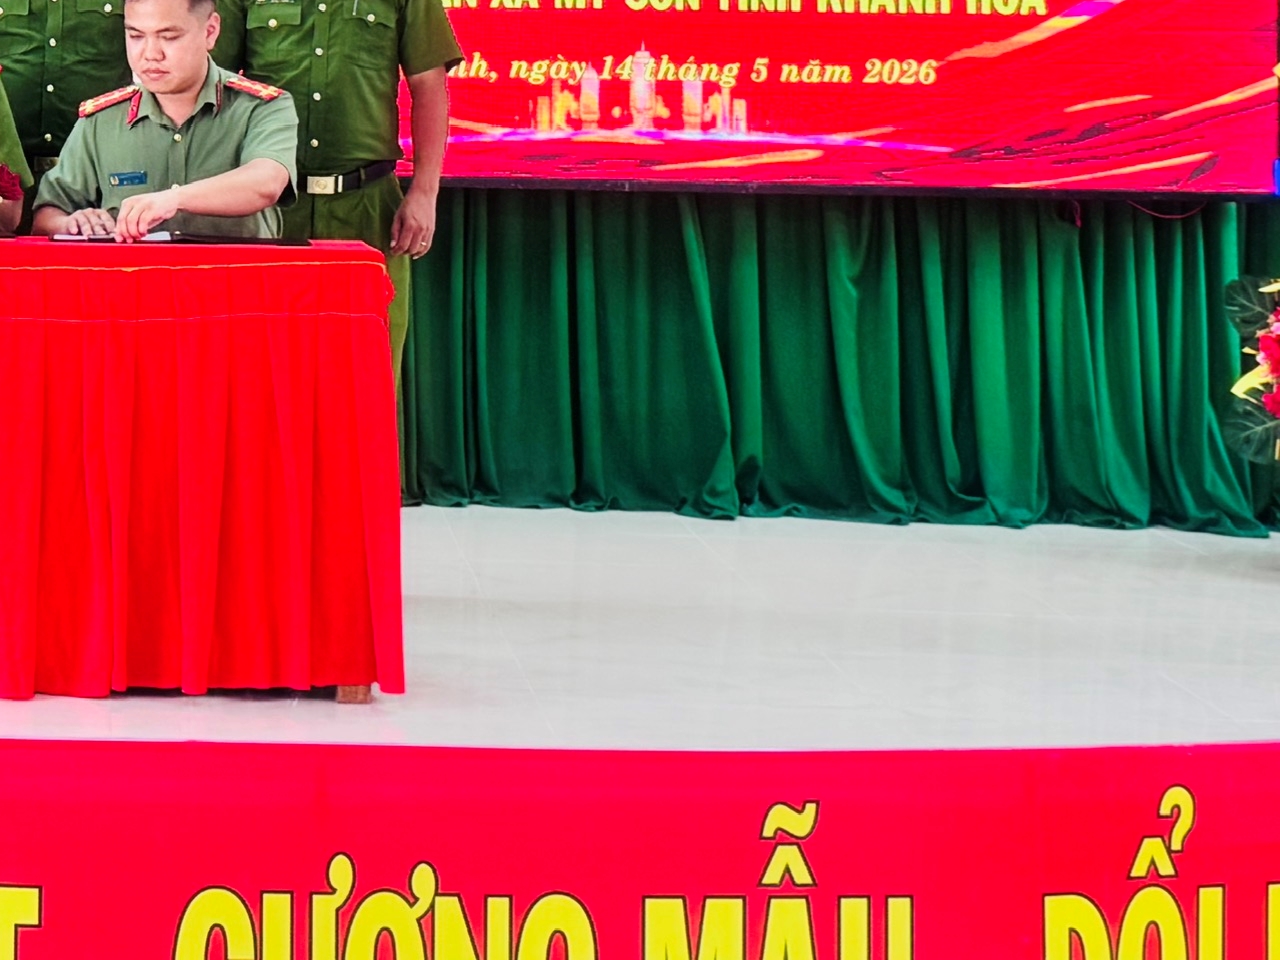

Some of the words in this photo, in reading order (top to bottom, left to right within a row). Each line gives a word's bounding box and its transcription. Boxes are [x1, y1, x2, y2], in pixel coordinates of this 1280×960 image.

[448, 51, 499, 84] nh,
[509, 54, 588, 85] ngày
[598, 55, 634, 80] 14
[643, 56, 740, 87] tháng
[751, 57, 769, 83] 5
[779, 59, 852, 84] năm
[862, 58, 939, 85] 2026
